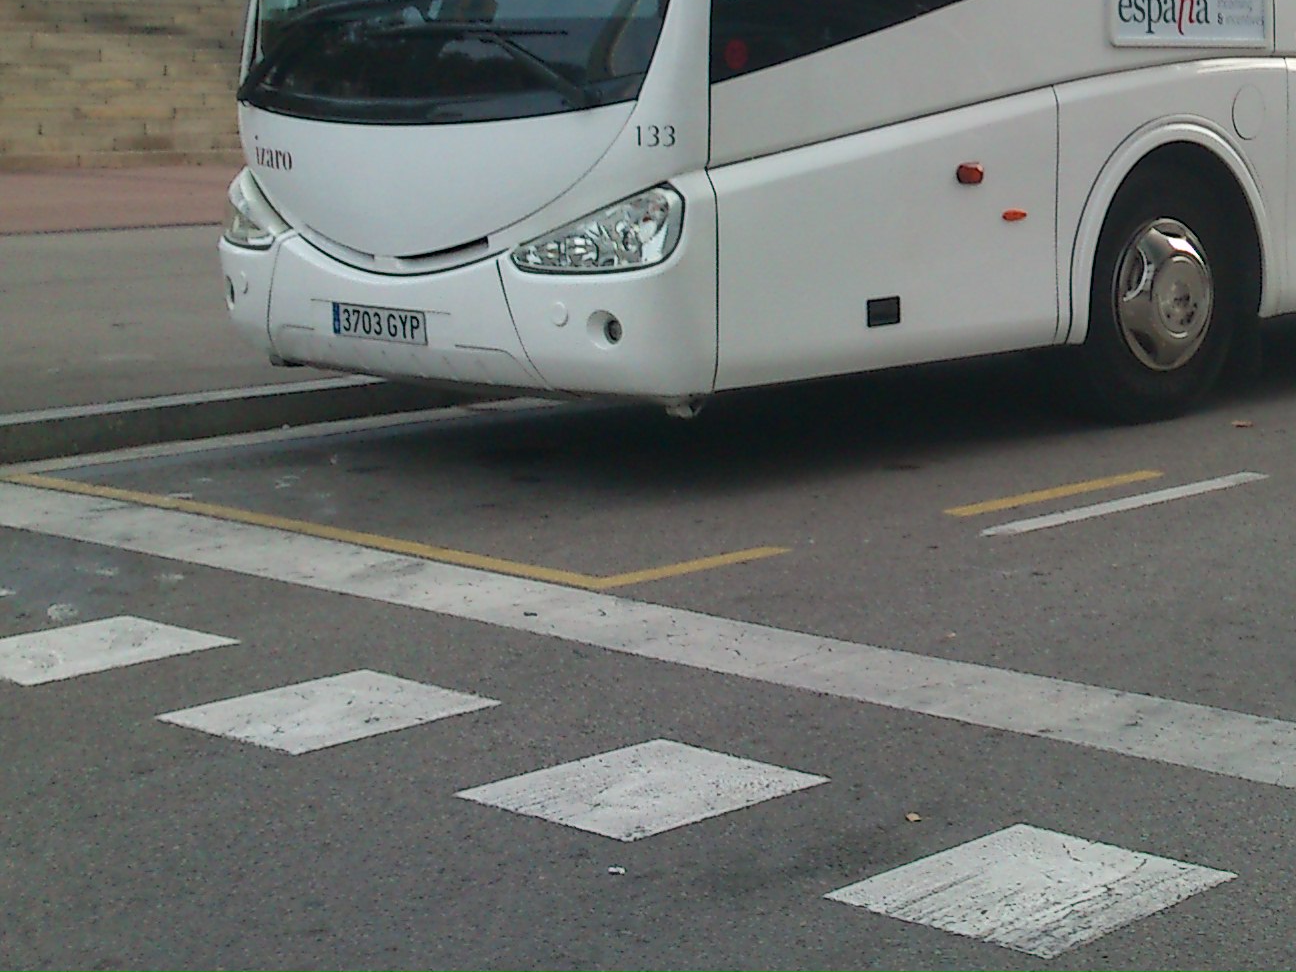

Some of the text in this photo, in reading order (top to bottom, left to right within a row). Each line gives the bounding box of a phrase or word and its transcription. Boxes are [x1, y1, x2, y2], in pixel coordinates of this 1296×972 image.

[636, 125, 676, 147] 133
[255, 134, 293, 171] izaro
[342, 308, 420, 340] 3703 GYP
